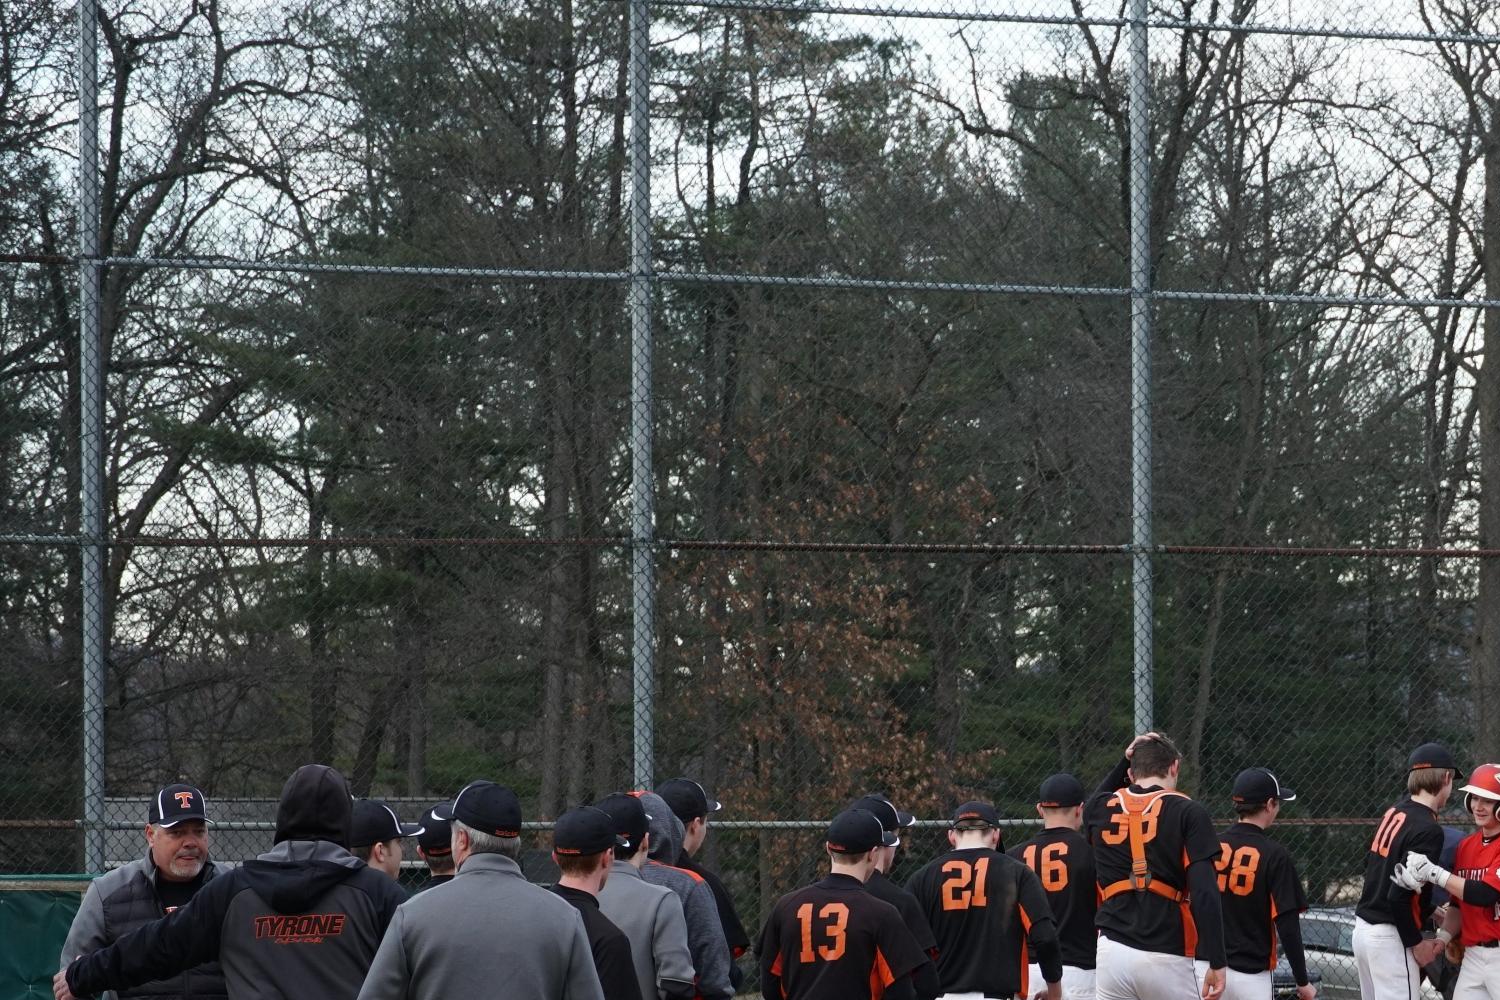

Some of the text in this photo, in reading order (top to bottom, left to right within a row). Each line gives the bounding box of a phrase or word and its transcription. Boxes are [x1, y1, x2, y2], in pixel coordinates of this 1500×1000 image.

[174, 791, 194, 809] T
[1370, 807, 1407, 858] 10
[941, 857, 990, 911] 21
[1022, 841, 1069, 892] 16
[1214, 842, 1261, 896] 28
[254, 913, 347, 940] TYRONE
[796, 902, 850, 963] 13
